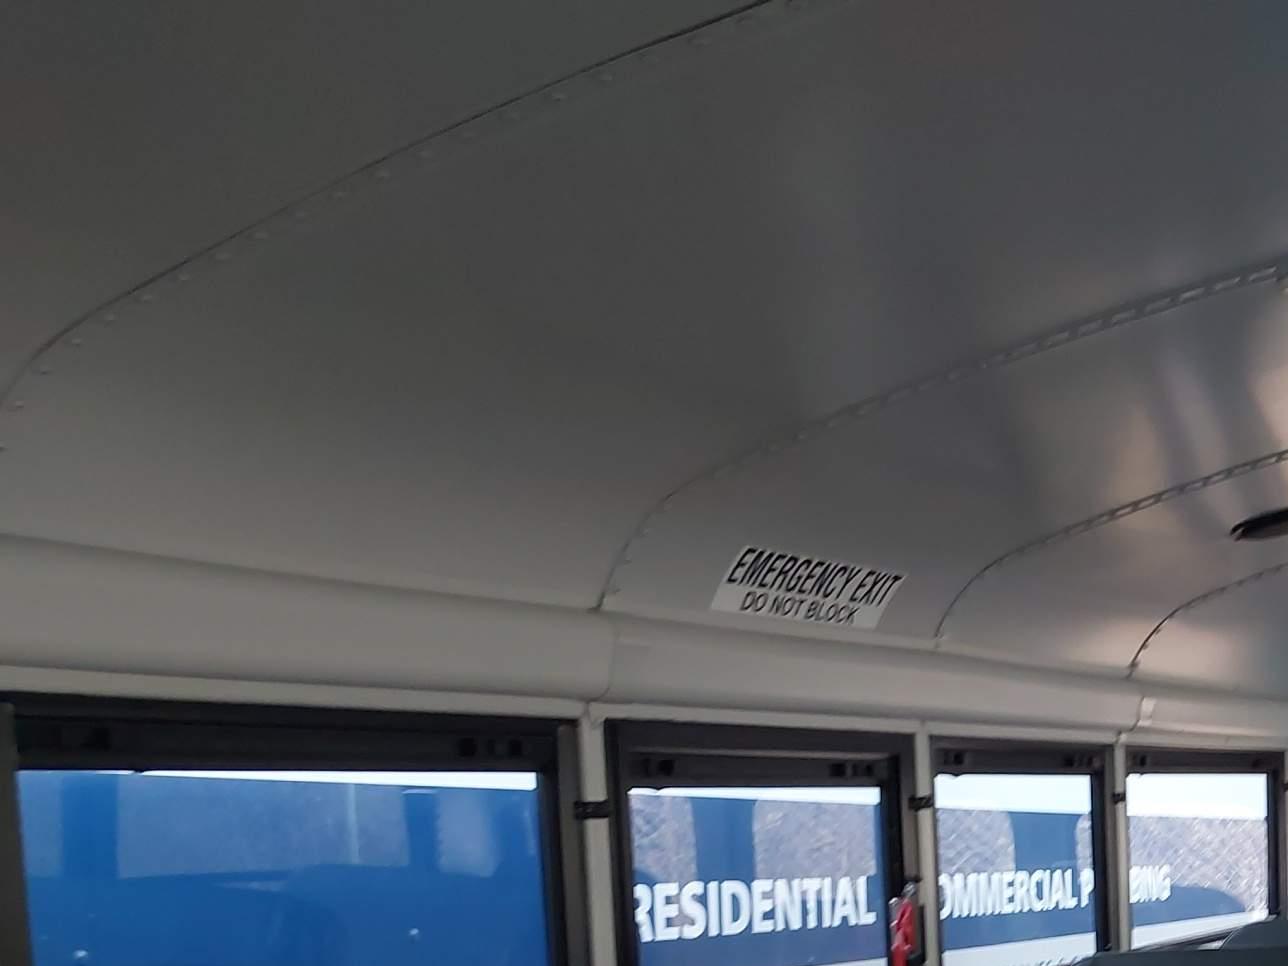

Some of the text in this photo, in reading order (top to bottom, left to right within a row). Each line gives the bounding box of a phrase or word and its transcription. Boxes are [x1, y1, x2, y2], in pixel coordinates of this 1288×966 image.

[726, 547, 904, 607] EMERGENCY EXIT
[739, 590, 860, 624] DO NOT BLOCK
[633, 875, 877, 942] RESIDENTIAL
[938, 868, 1078, 921] OMMERCIAL
